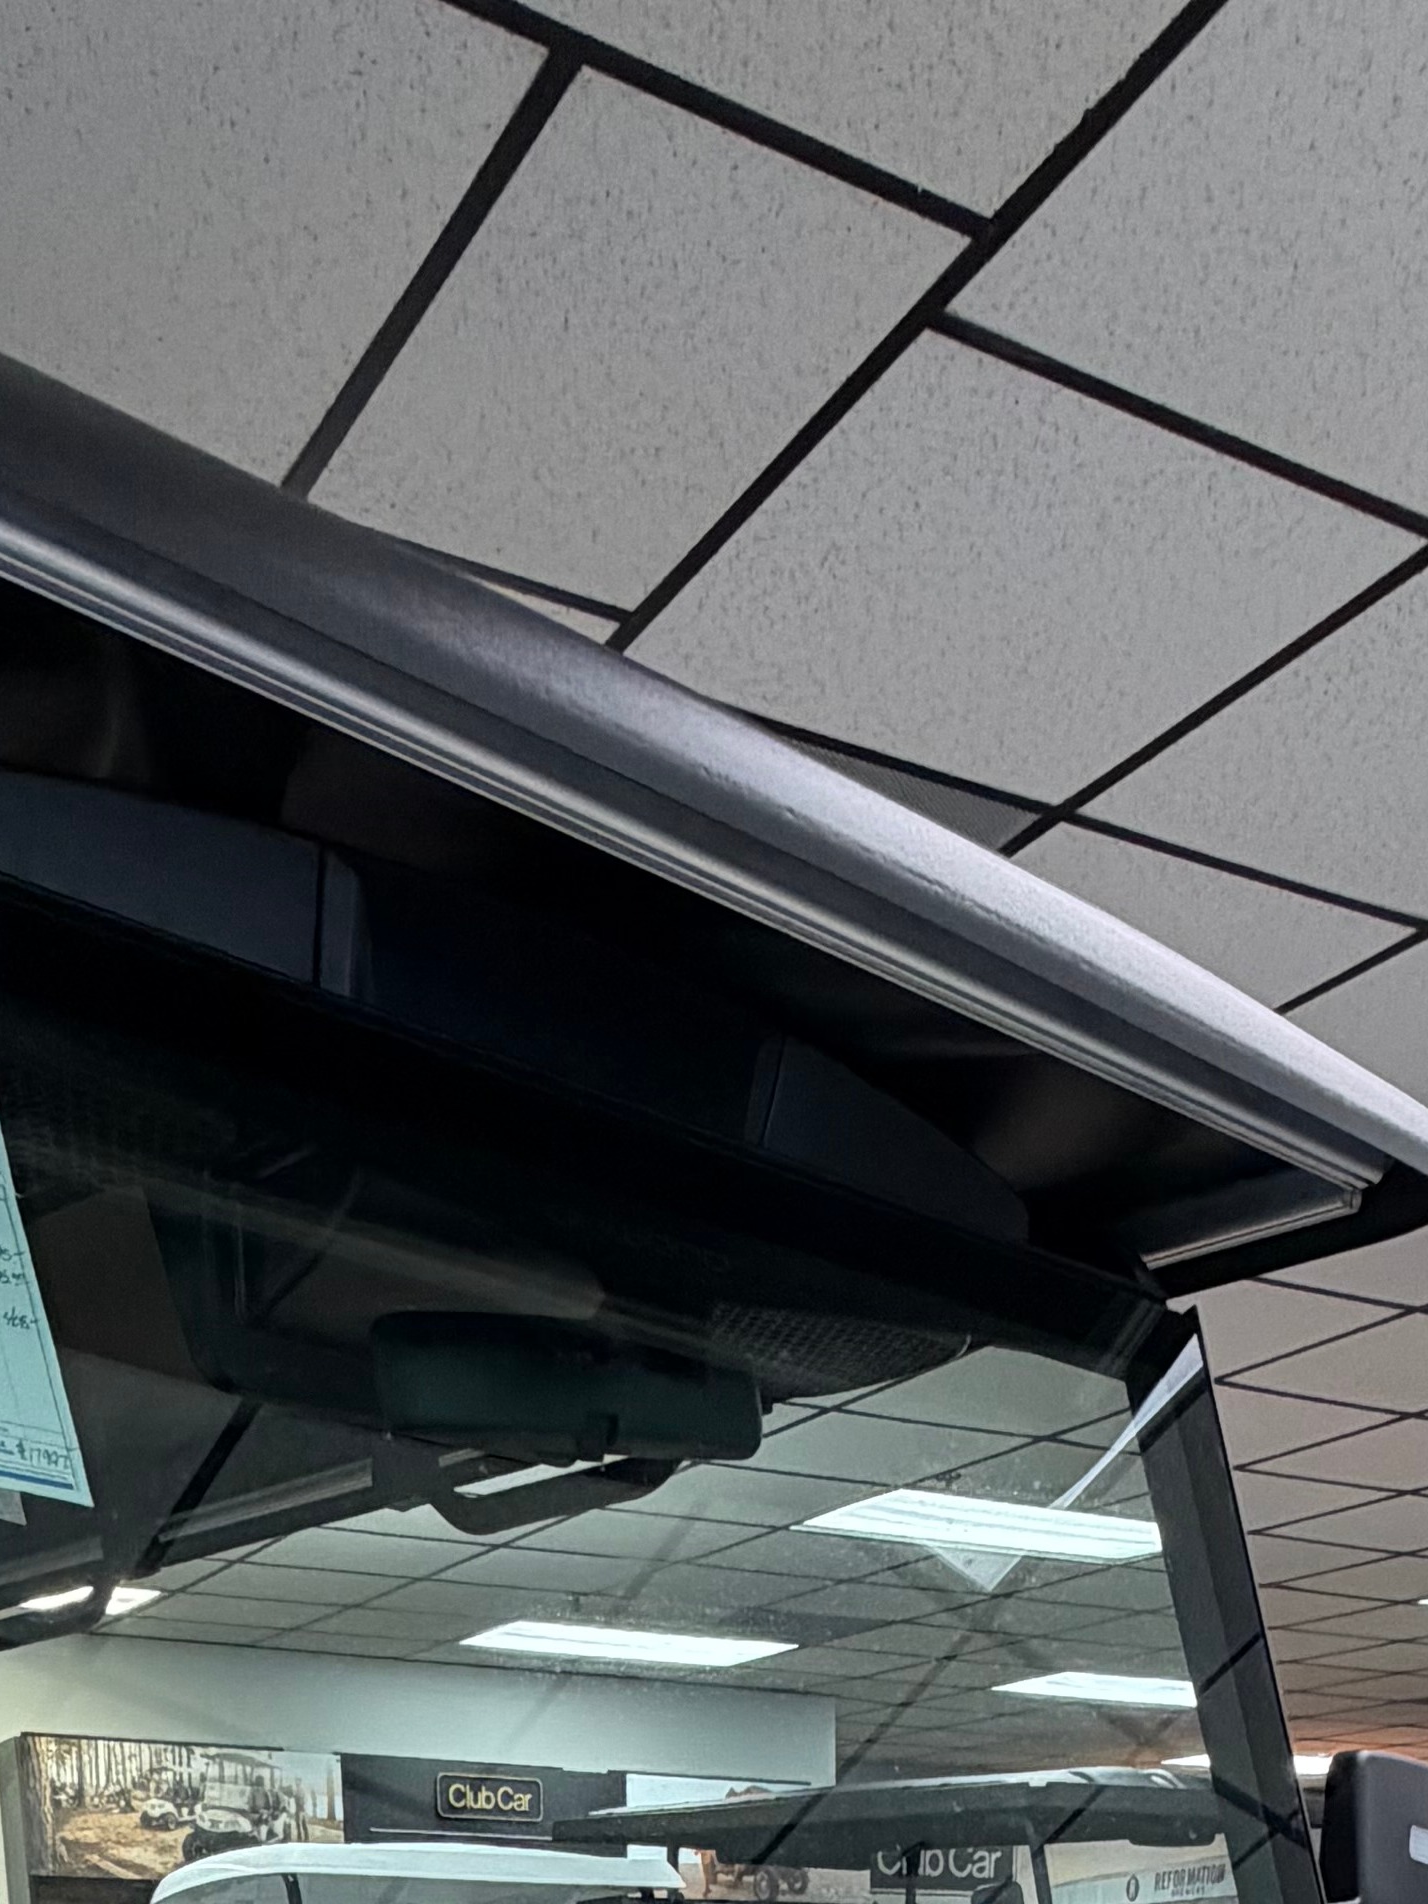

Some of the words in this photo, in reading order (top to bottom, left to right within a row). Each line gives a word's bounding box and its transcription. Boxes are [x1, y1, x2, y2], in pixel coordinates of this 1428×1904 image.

[448, 1783, 496, 1809] Club
[497, 1786, 533, 1812] Car
[948, 1848, 1002, 1879] Car
